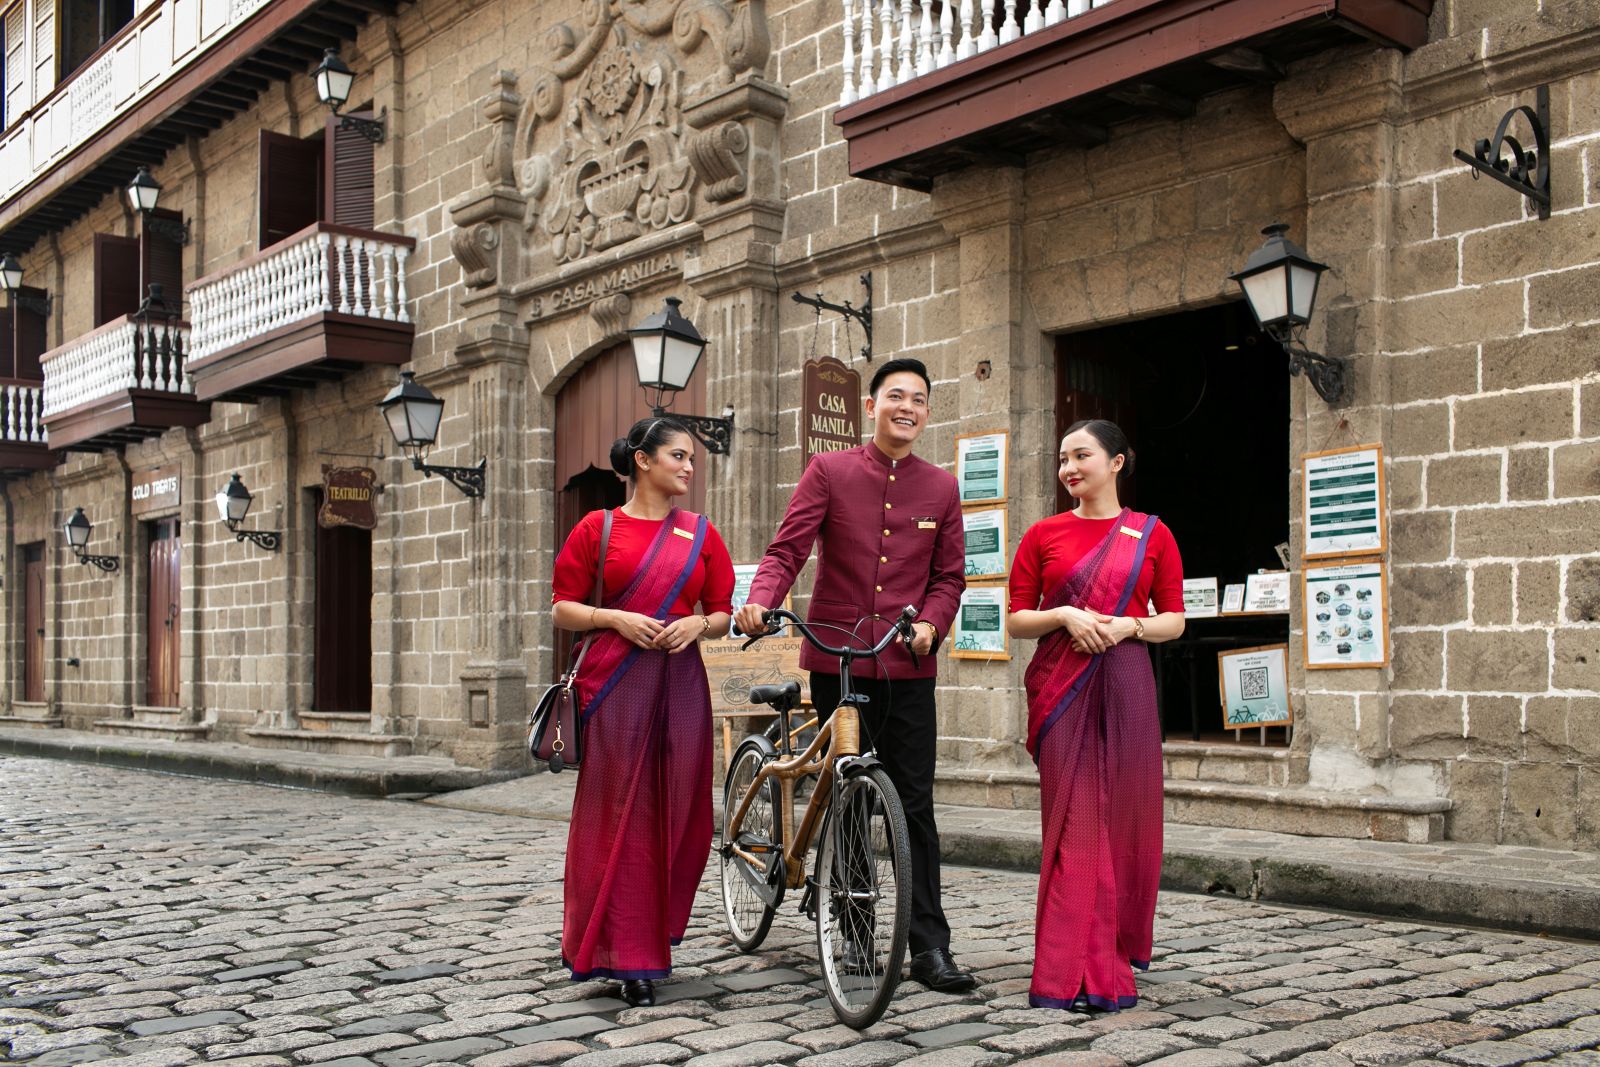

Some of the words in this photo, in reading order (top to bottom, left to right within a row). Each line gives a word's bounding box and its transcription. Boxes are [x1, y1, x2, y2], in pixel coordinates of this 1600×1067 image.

[551, 281, 600, 309] CASA
[602, 253, 677, 292] MANILA
[819, 393, 847, 414] CASA
[812, 414, 855, 437] MANILA
[132, 483, 150, 499] COLD
[152, 476, 177, 495] TREATS
[329, 486, 370, 500] TEATRILLO
